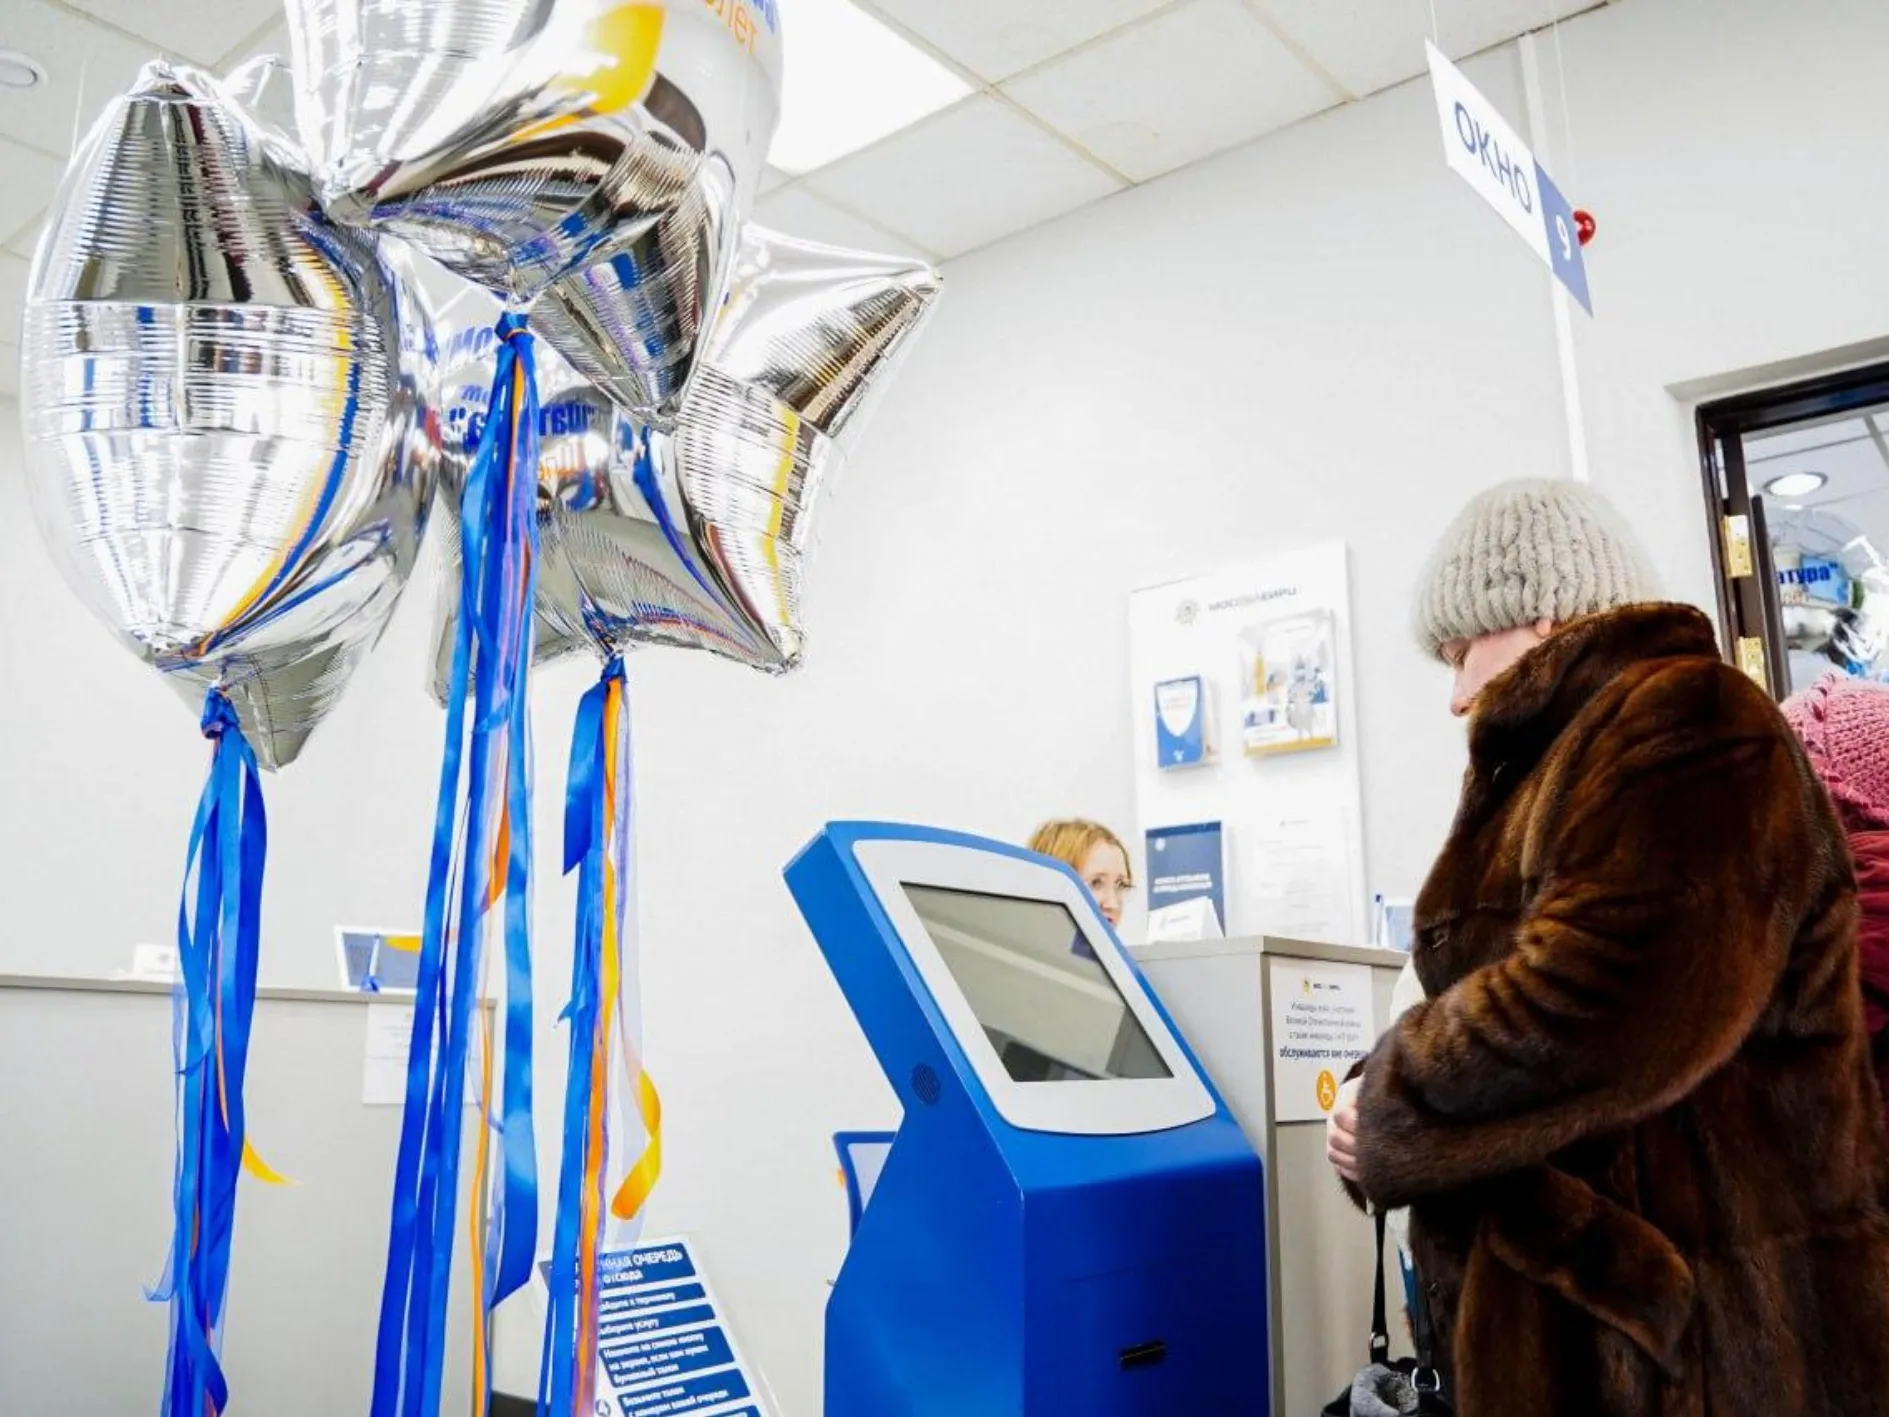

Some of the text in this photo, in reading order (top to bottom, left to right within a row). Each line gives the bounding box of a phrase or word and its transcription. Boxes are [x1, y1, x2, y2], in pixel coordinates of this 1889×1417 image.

[1454, 100, 1571, 261] ОКНО 9
[632, 1249, 683, 1266] ОЧЕРЕДЬ
